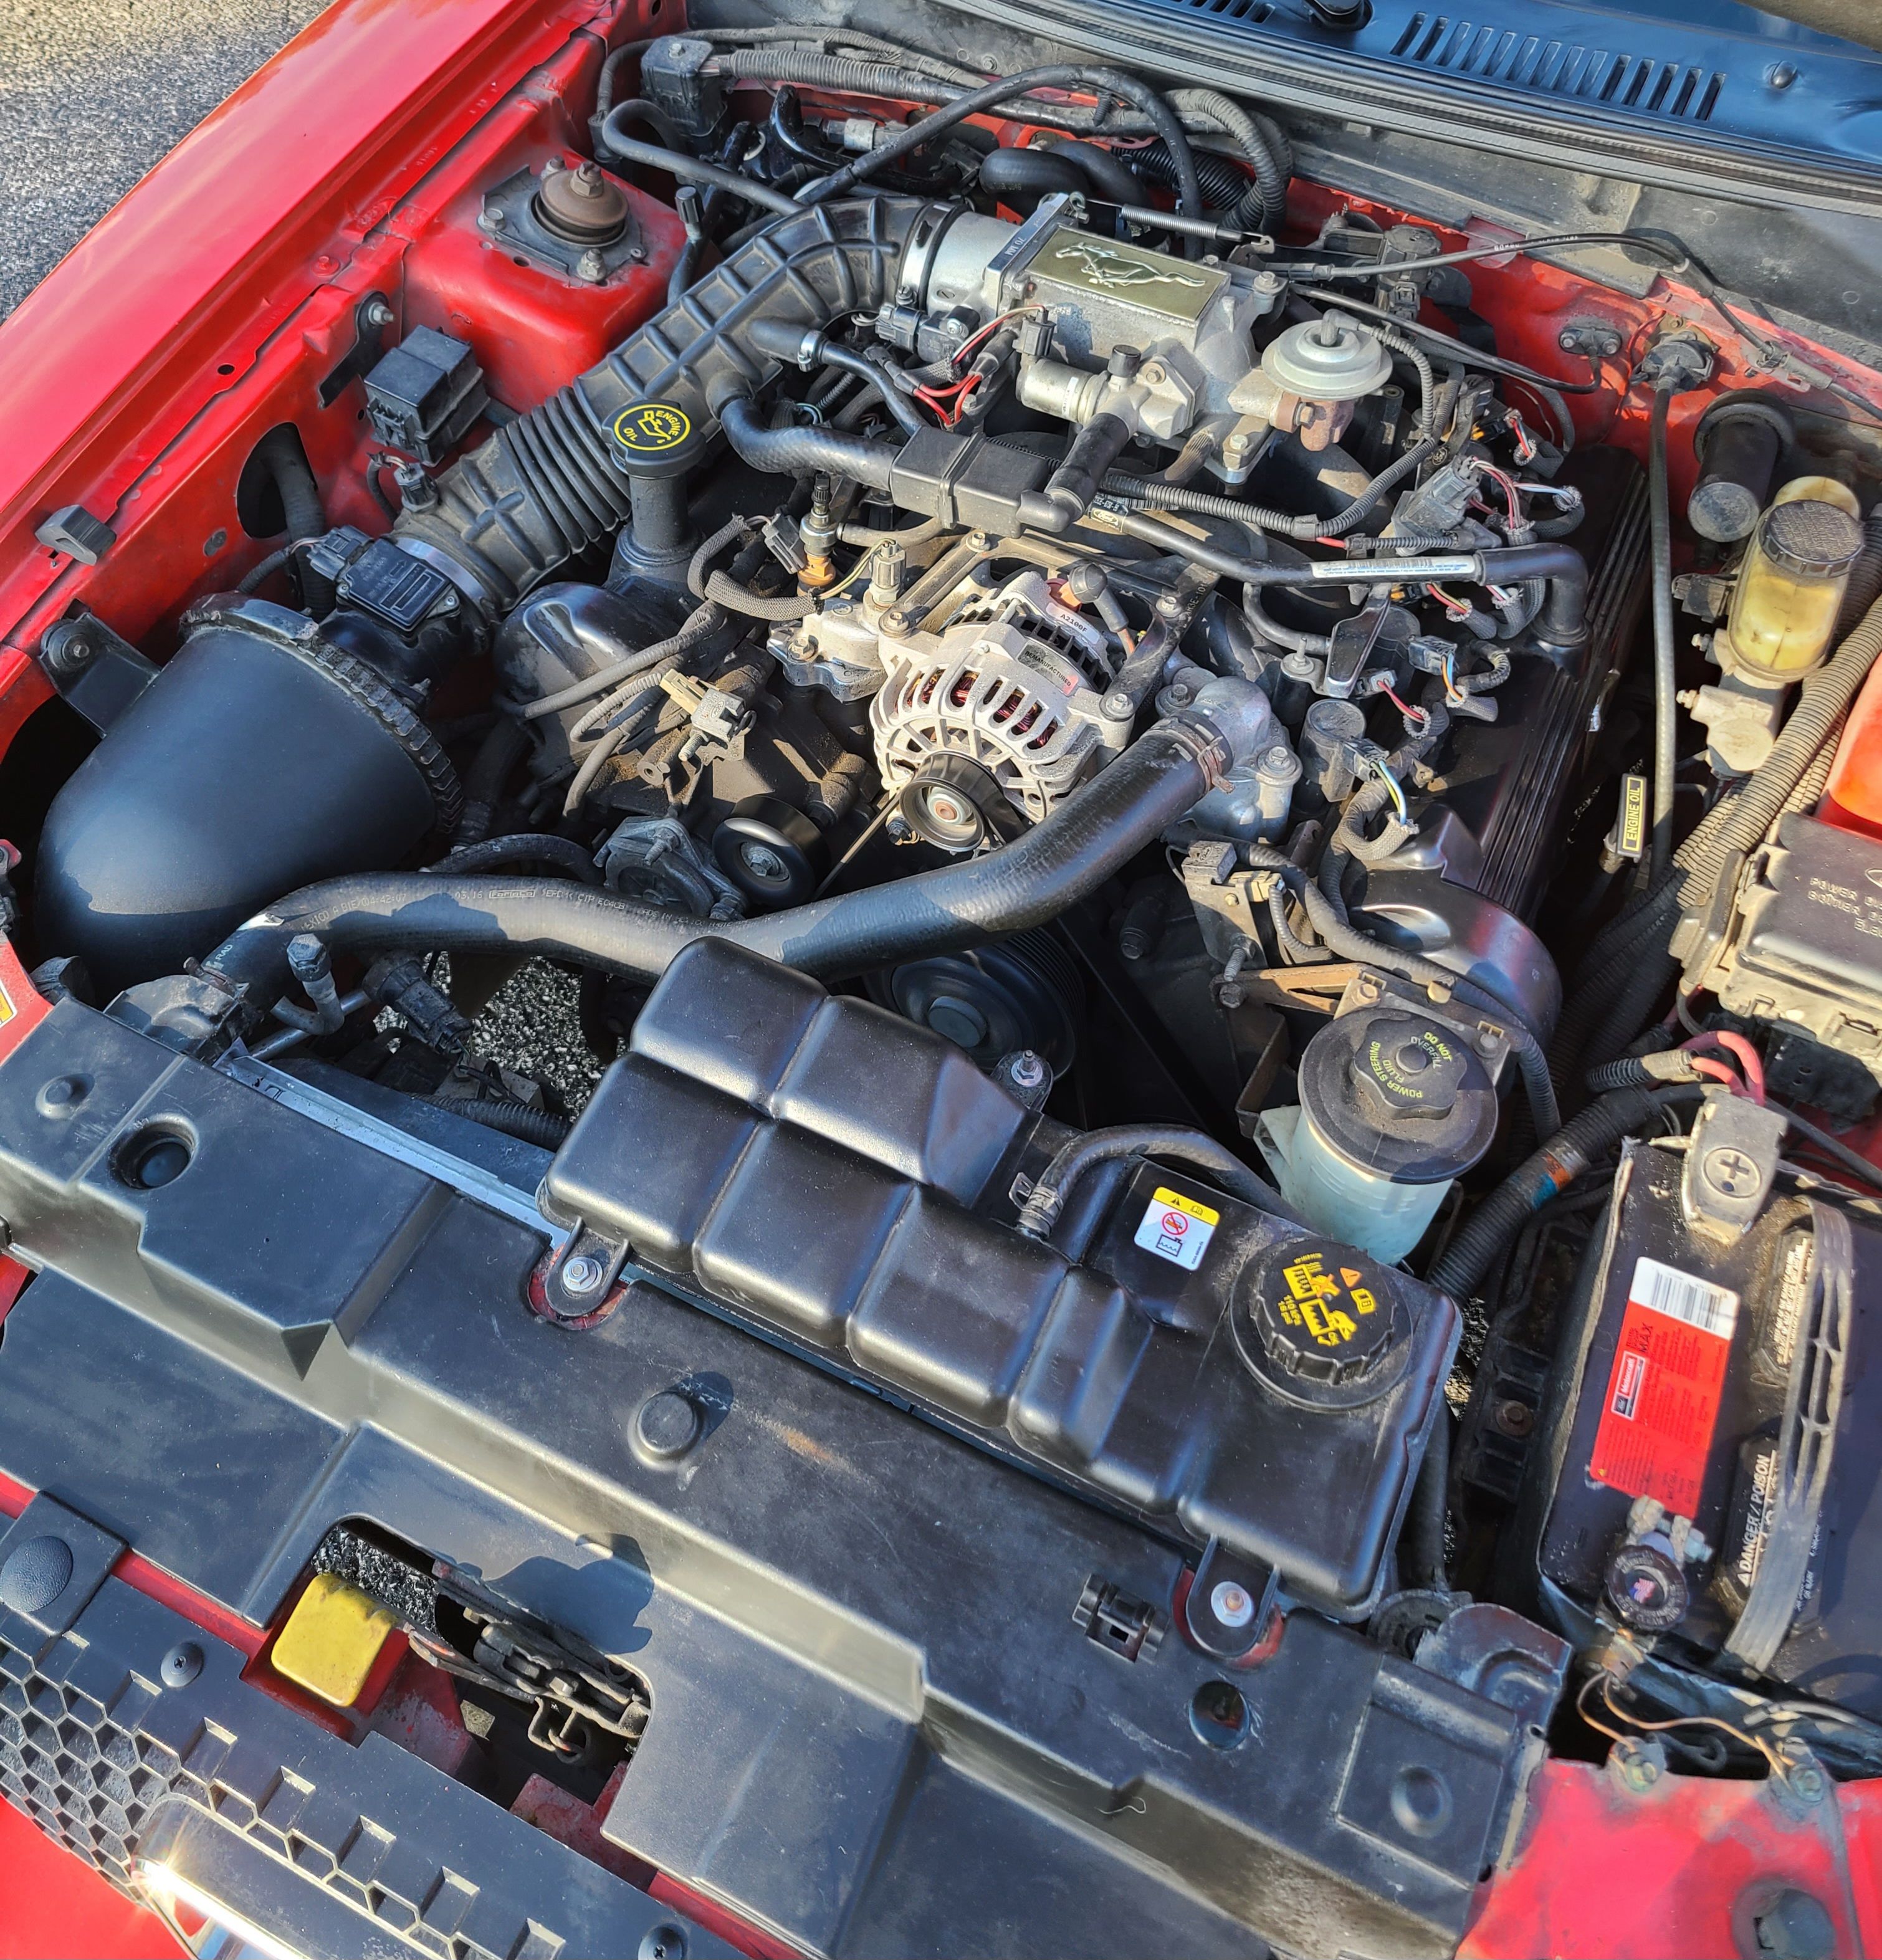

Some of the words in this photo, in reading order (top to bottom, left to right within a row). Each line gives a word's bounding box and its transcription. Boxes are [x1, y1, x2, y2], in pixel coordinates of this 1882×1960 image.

[1005, 244, 1018, 257] MM
[1015, 235, 1025, 246] 70
[623, 427, 638, 441] OIL
[655, 411, 681, 436] ENGINE
[1060, 614, 1087, 633] A2100F
[1025, 651, 1071, 686] REMANUFACTURED
[1630, 787, 1640, 802] OIL
[1627, 804, 1640, 841] ENGINE
[1810, 877, 1858, 901] POWER
[216, 944, 234, 961] RAD
[1410, 1036, 1443, 1069] OVERFILL
[1423, 1031, 1437, 1044] DO
[1436, 1042, 1453, 1062] NOT
[1369, 1040, 1387, 1082] STEERING
[1382, 1059, 1405, 1083] FLUID
[1387, 1081, 1423, 1099] POWER
[1640, 1322, 1654, 1352] MAX
[1739, 1513, 1761, 1572] DANGER
[1751, 1454, 1770, 1503] POISON
